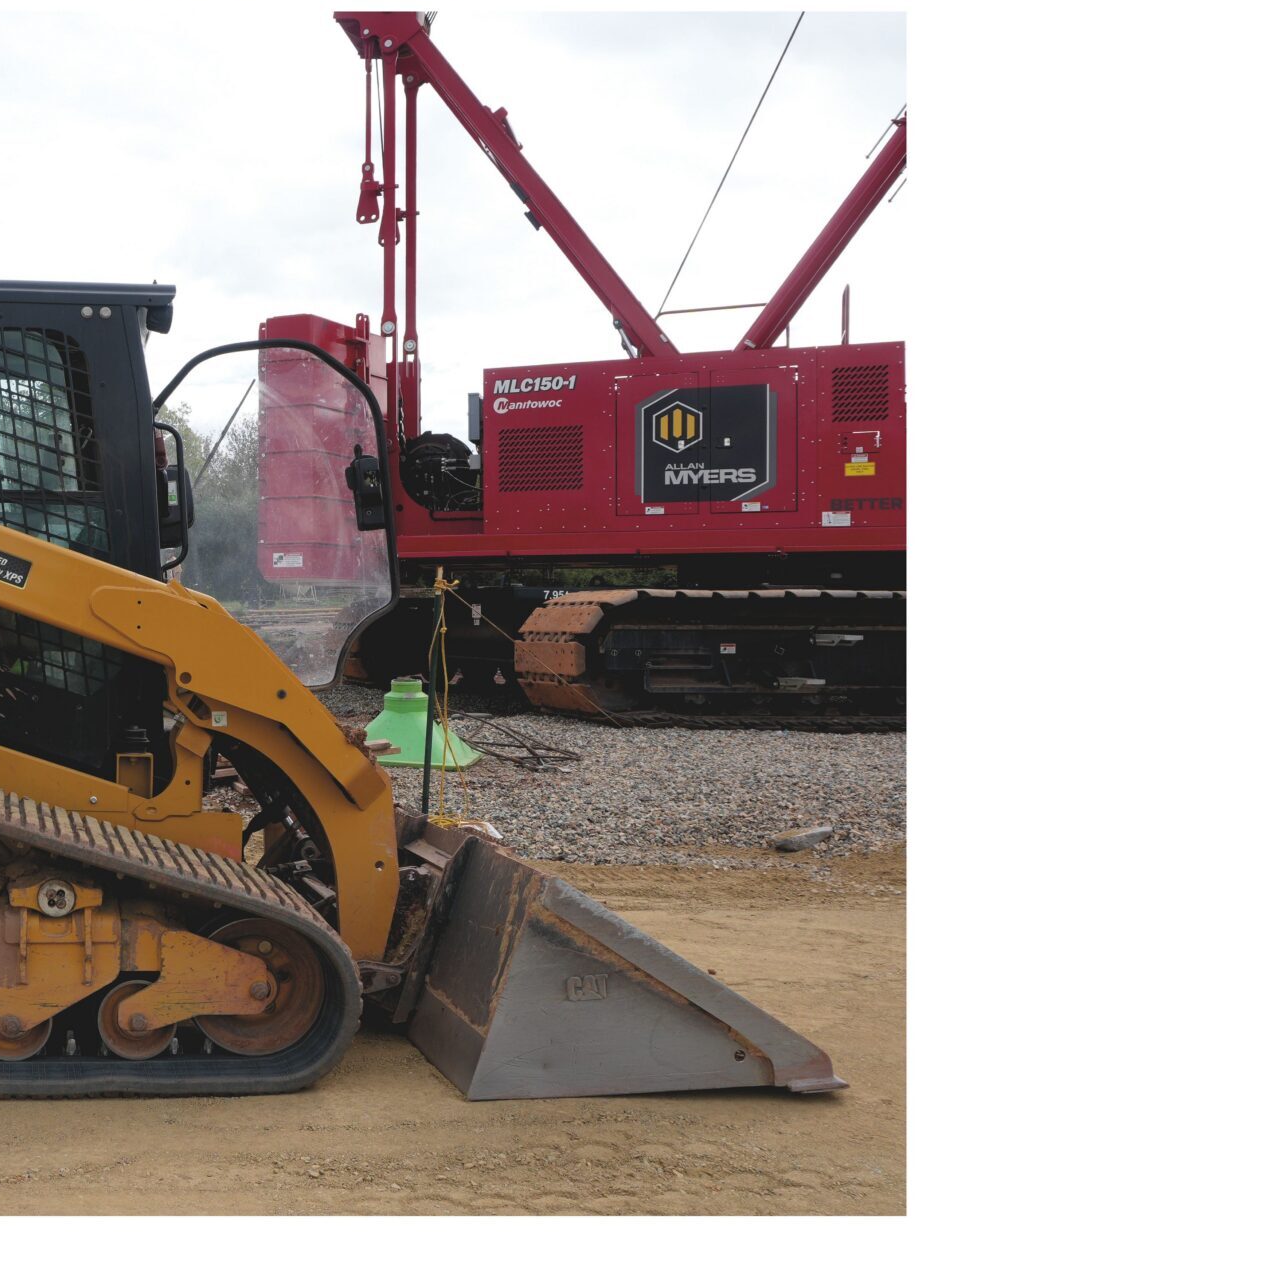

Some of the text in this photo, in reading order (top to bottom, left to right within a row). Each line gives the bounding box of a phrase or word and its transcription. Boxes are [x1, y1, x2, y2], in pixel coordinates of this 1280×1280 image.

[493, 375, 576, 394] MLC150-1
[493, 397, 562, 414] Manitowoc
[664, 462, 705, 471] ALLAN
[664, 468, 757, 486] MYERS
[830, 497, 902, 511] BETTER
[3, 570, 24, 584] XPS
[566, 973, 608, 1001] CAT
